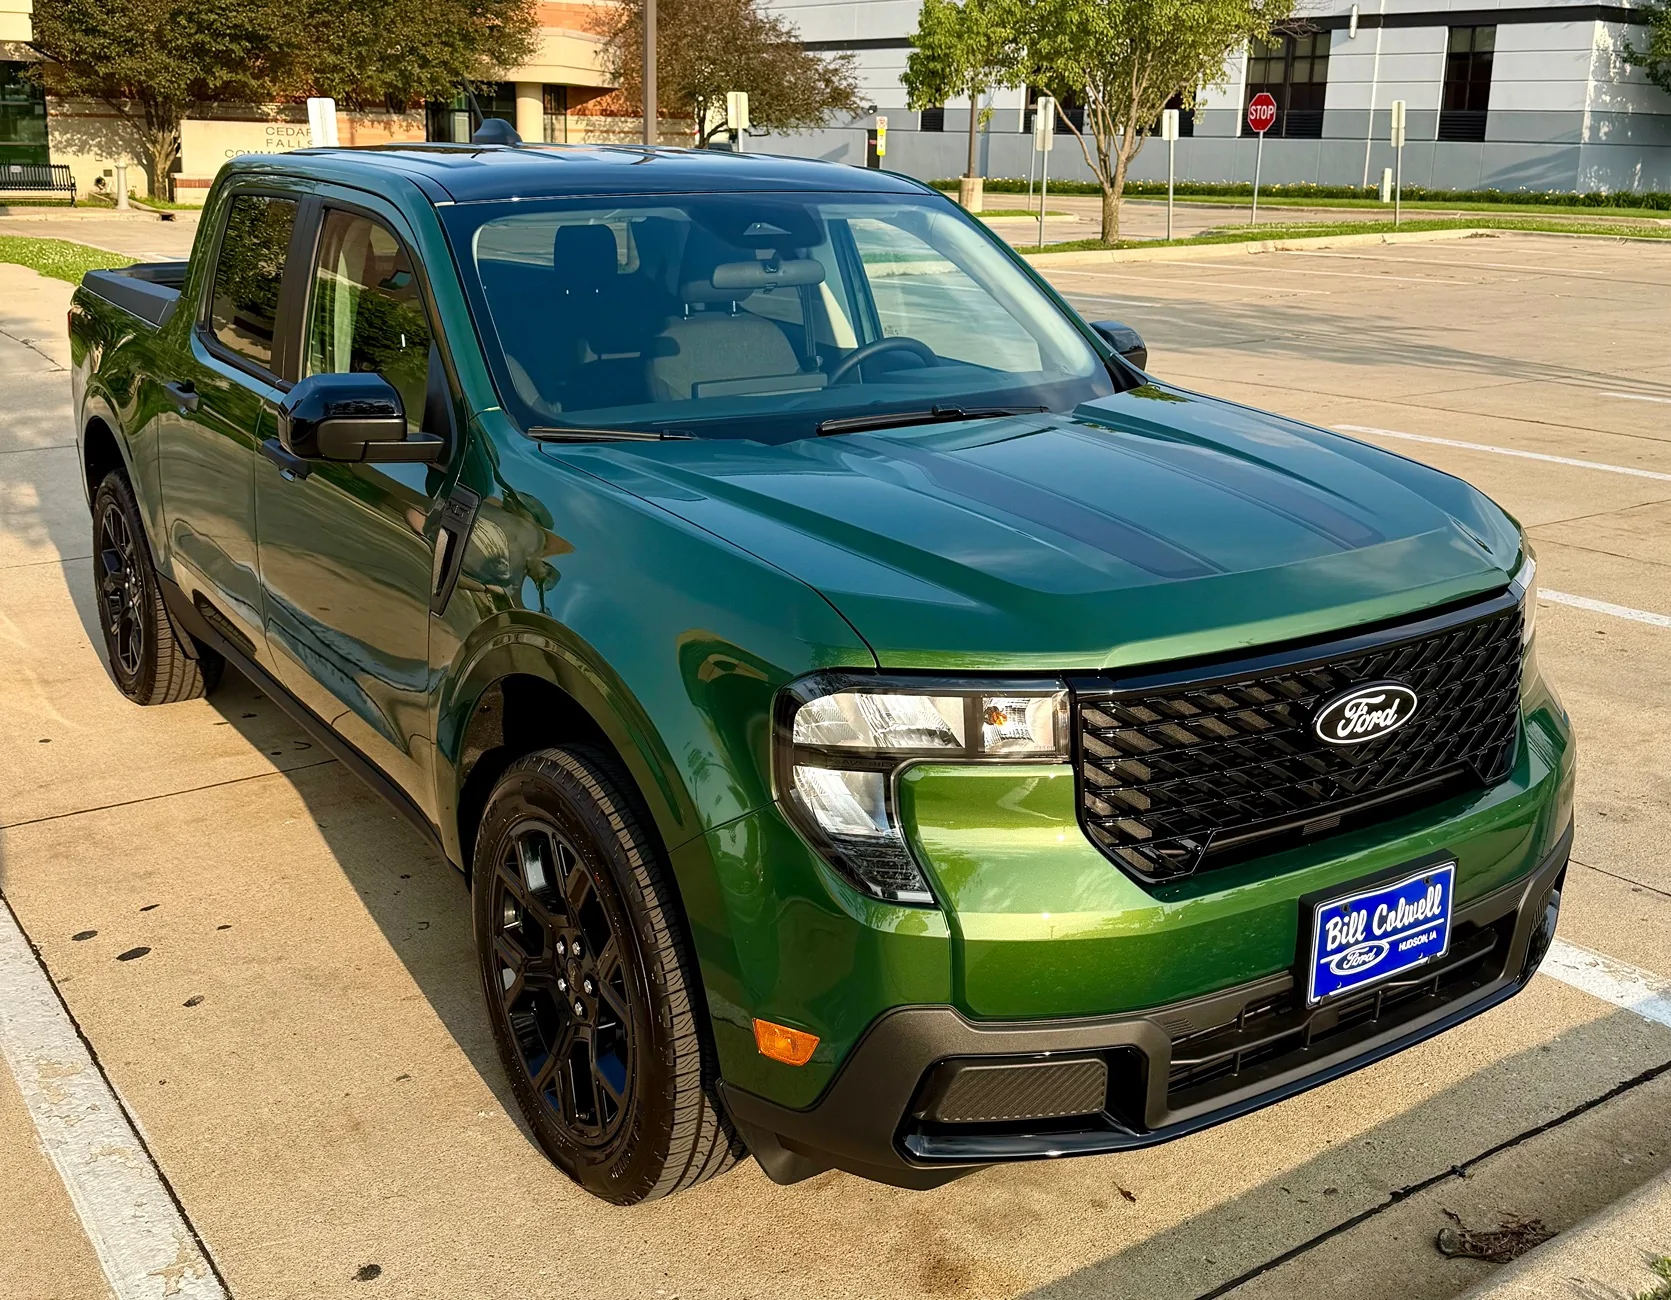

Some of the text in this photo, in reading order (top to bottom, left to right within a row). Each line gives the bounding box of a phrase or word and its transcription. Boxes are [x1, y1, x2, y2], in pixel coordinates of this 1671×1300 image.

[1249, 105, 1275, 120] STOP
[265, 138, 313, 148] FALLS
[1336, 693, 1400, 737] Ford
[1325, 883, 1443, 951] Bill Colwell
[1342, 947, 1377, 969] Ford
